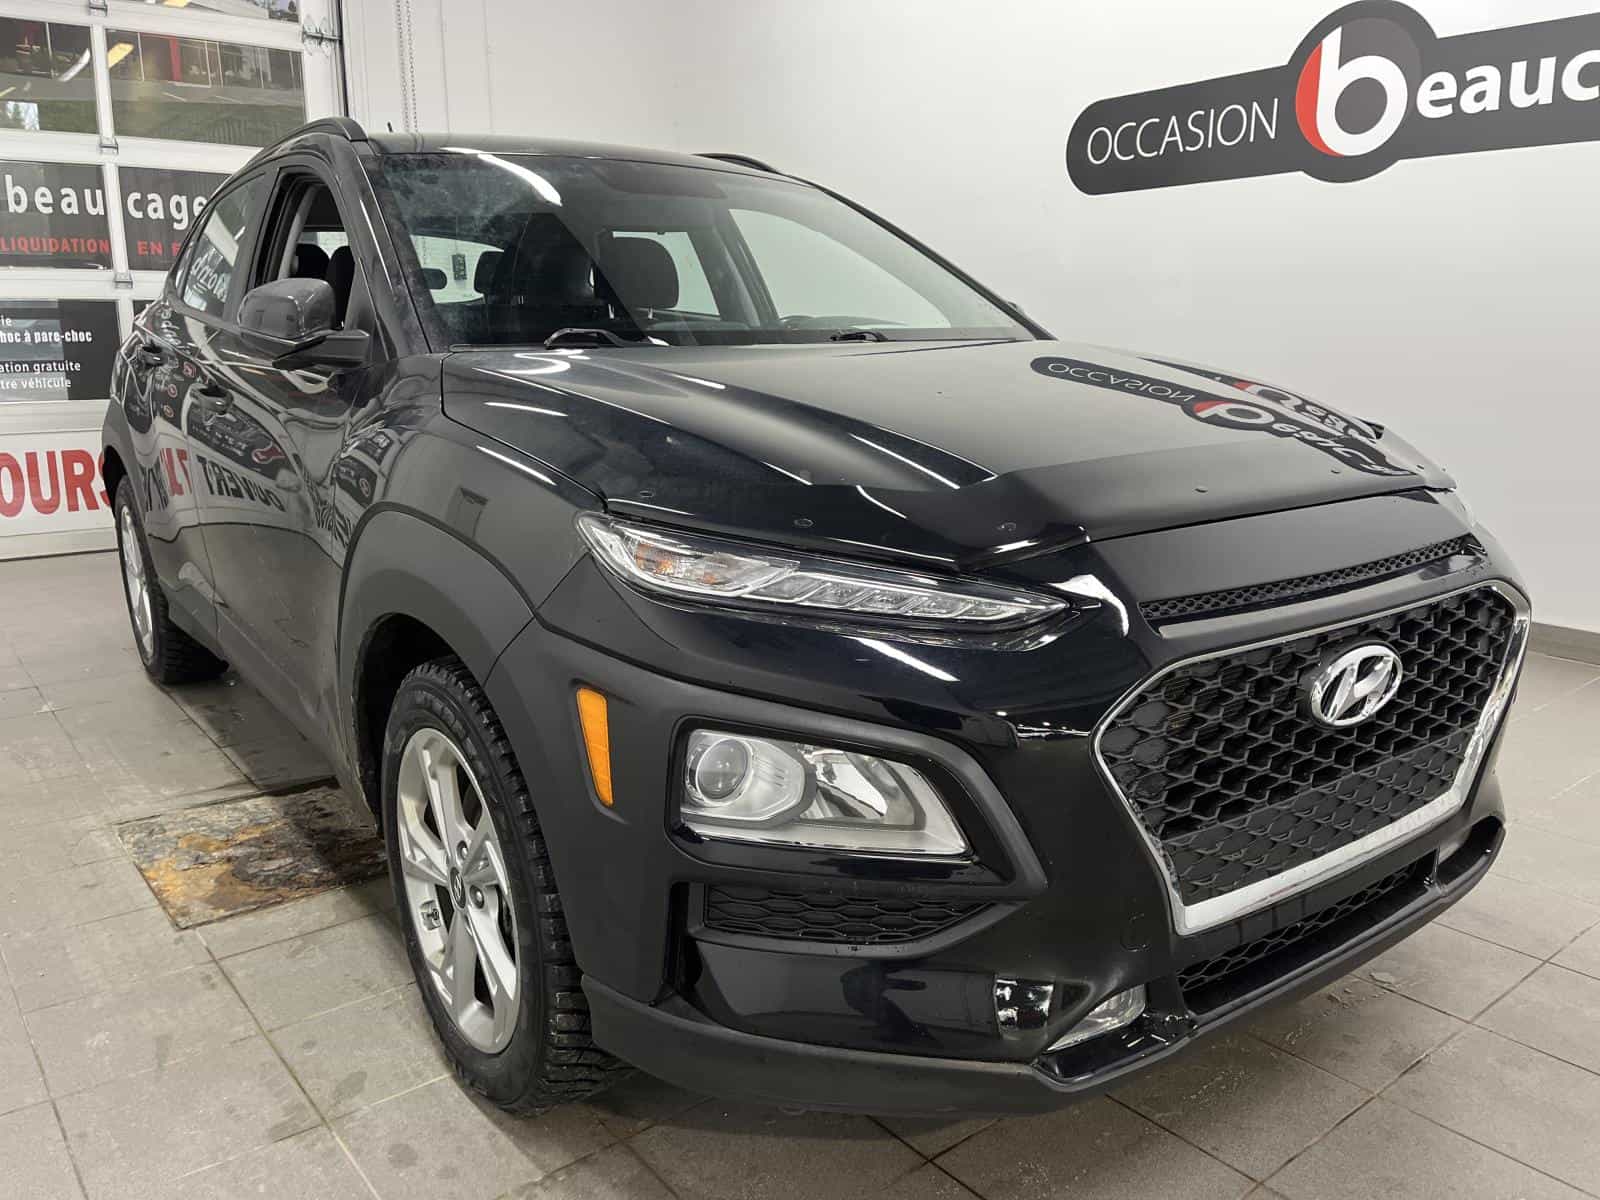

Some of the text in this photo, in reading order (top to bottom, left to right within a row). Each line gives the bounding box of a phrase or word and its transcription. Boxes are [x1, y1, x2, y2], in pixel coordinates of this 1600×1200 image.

[1086, 98, 1279, 166] OCCASION
[0, 236, 111, 254] LIQUIDATION
[137, 240, 163, 256] EN
[34, 329, 93, 344] pare-choc
[33, 360, 81, 374] gratuite
[21, 376, 72, 389] véhicule
